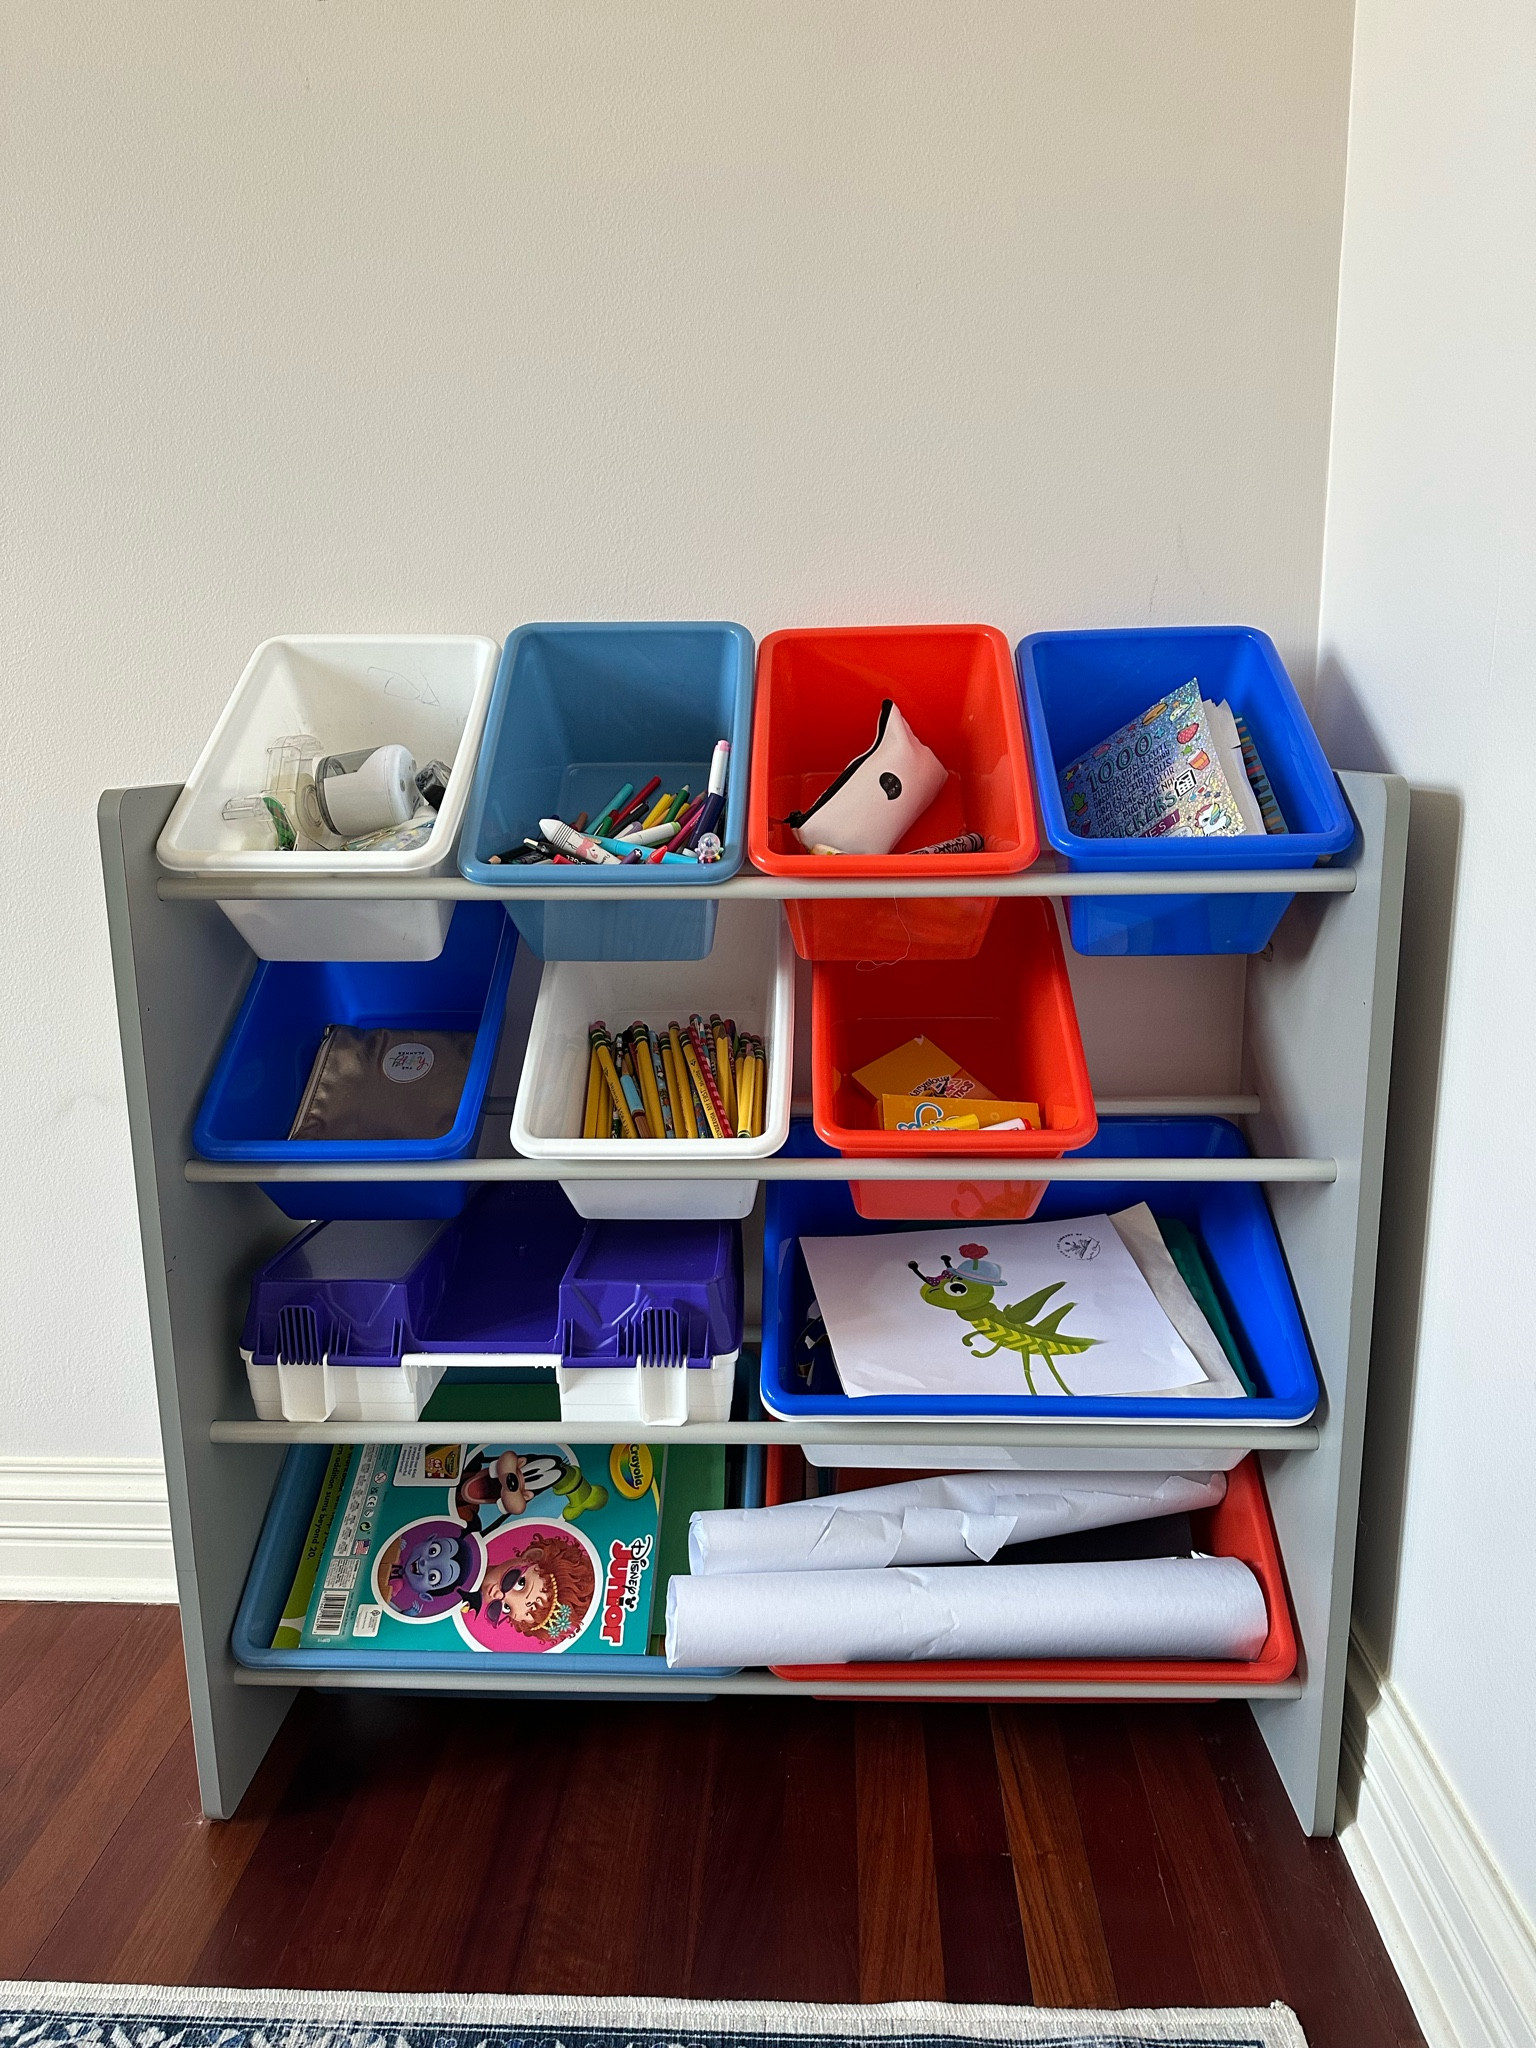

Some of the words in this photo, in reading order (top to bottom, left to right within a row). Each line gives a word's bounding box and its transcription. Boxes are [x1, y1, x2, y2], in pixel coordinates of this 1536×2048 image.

[1086, 732, 1153, 793] 1000
[1111, 791, 1176, 838] TICKERS
[327, 1457, 341, 1489] addition
[629, 1444, 644, 1488] Crayola
[322, 1491, 332, 1511] sums
[312, 1514, 327, 1544] beyond
